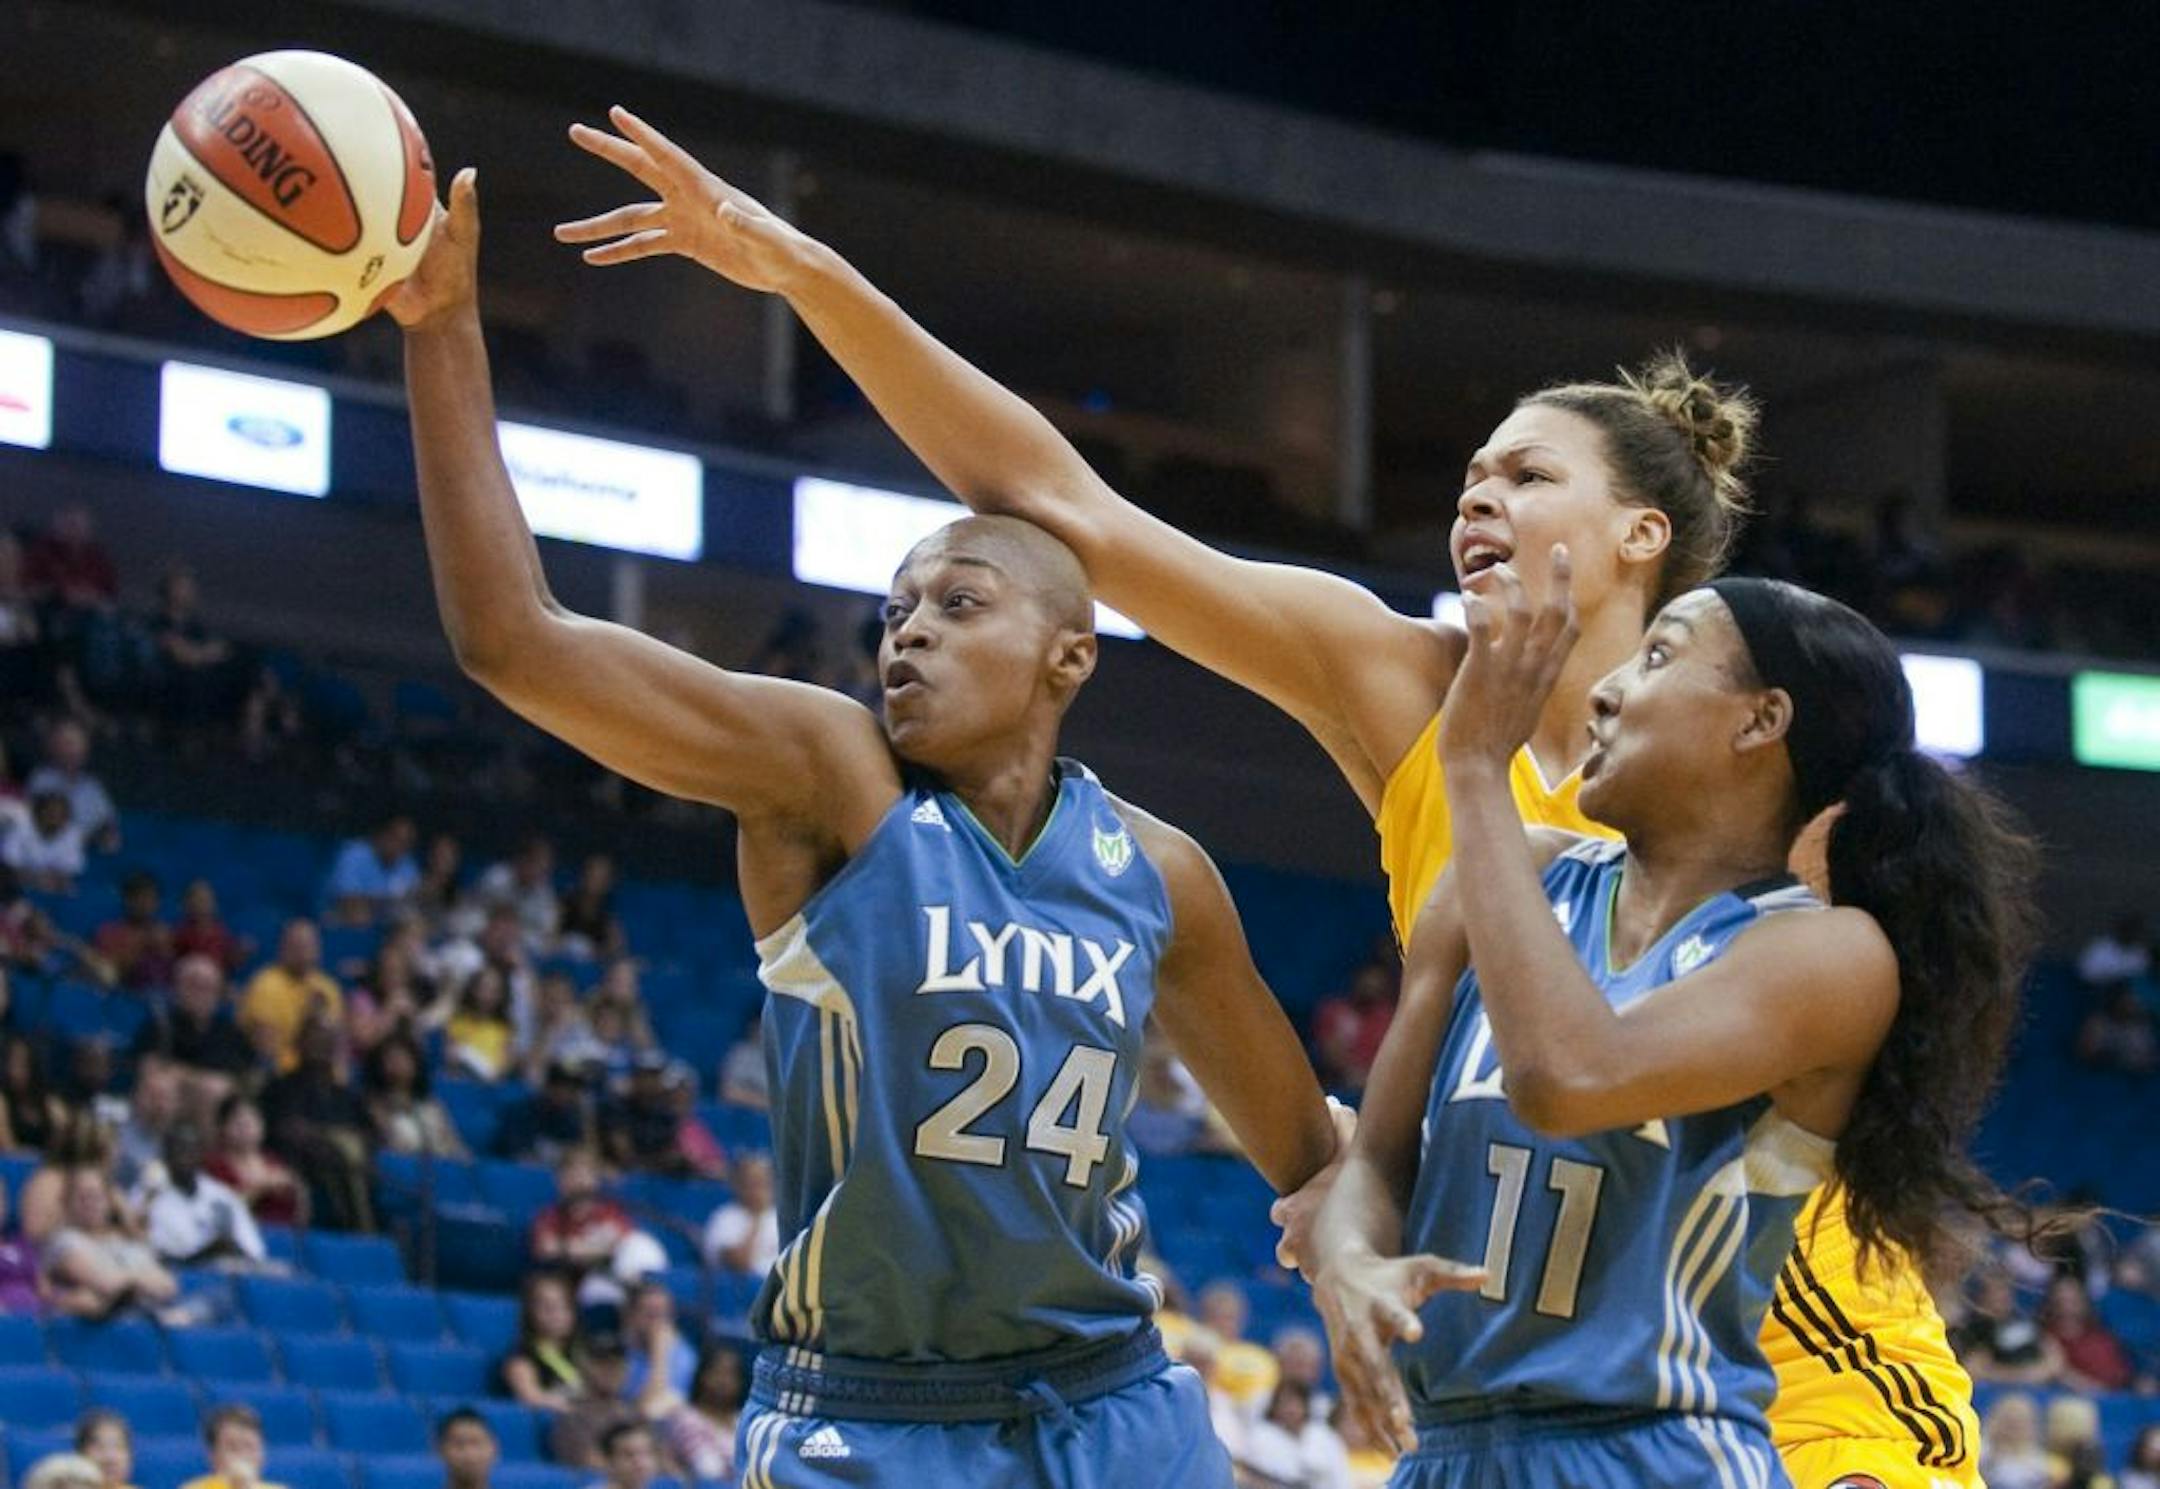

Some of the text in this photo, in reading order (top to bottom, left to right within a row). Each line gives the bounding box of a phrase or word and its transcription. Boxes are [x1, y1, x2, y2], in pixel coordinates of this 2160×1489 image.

[915, 905, 1137, 1028] LYNX
[914, 1023, 1118, 1188] 24
[1480, 1142, 1604, 1317] 11
